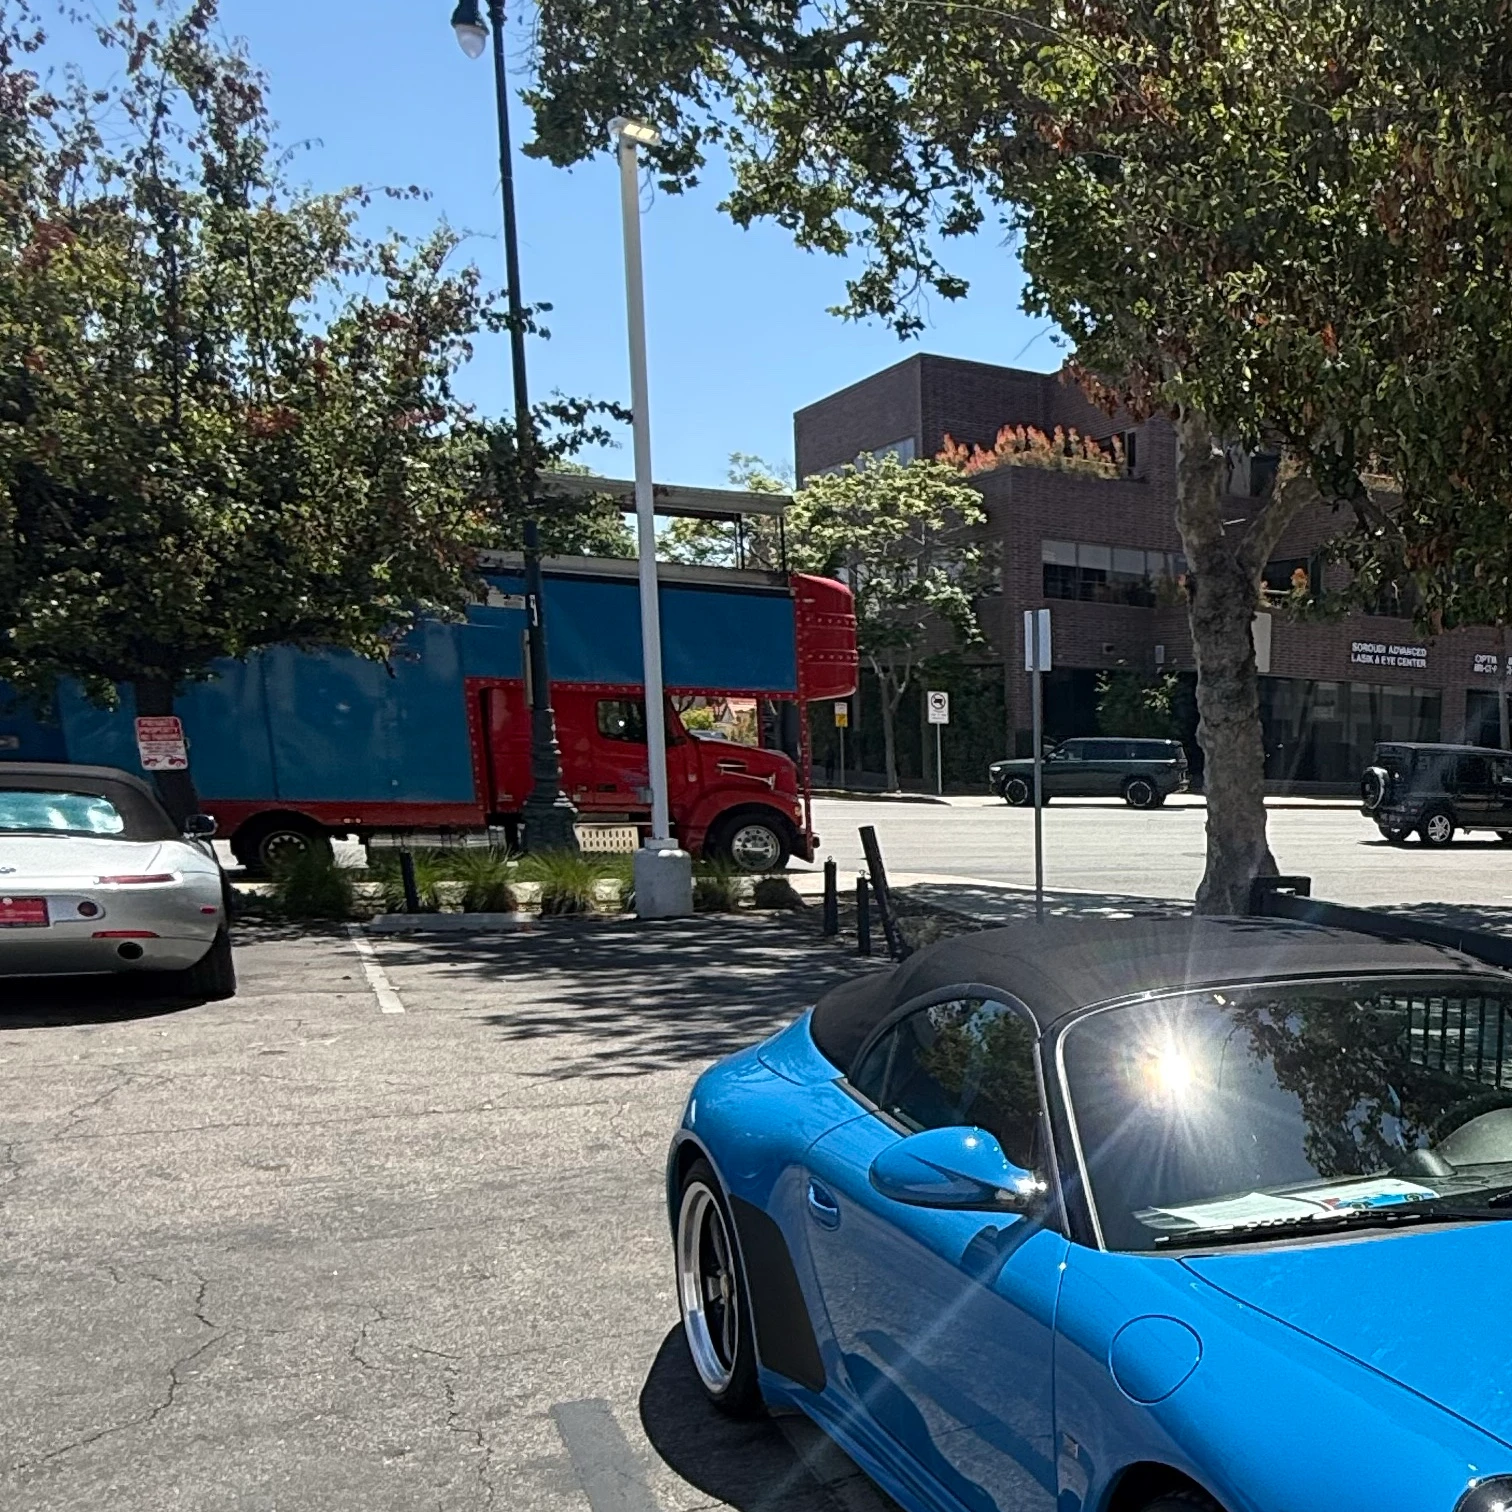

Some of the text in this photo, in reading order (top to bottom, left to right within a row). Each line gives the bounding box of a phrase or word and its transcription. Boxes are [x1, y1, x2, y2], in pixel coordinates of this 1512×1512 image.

[1388, 645, 1428, 657] ADVANCED
[1381, 656, 1396, 666] EYE
[1397, 657, 1427, 668] CENTER
